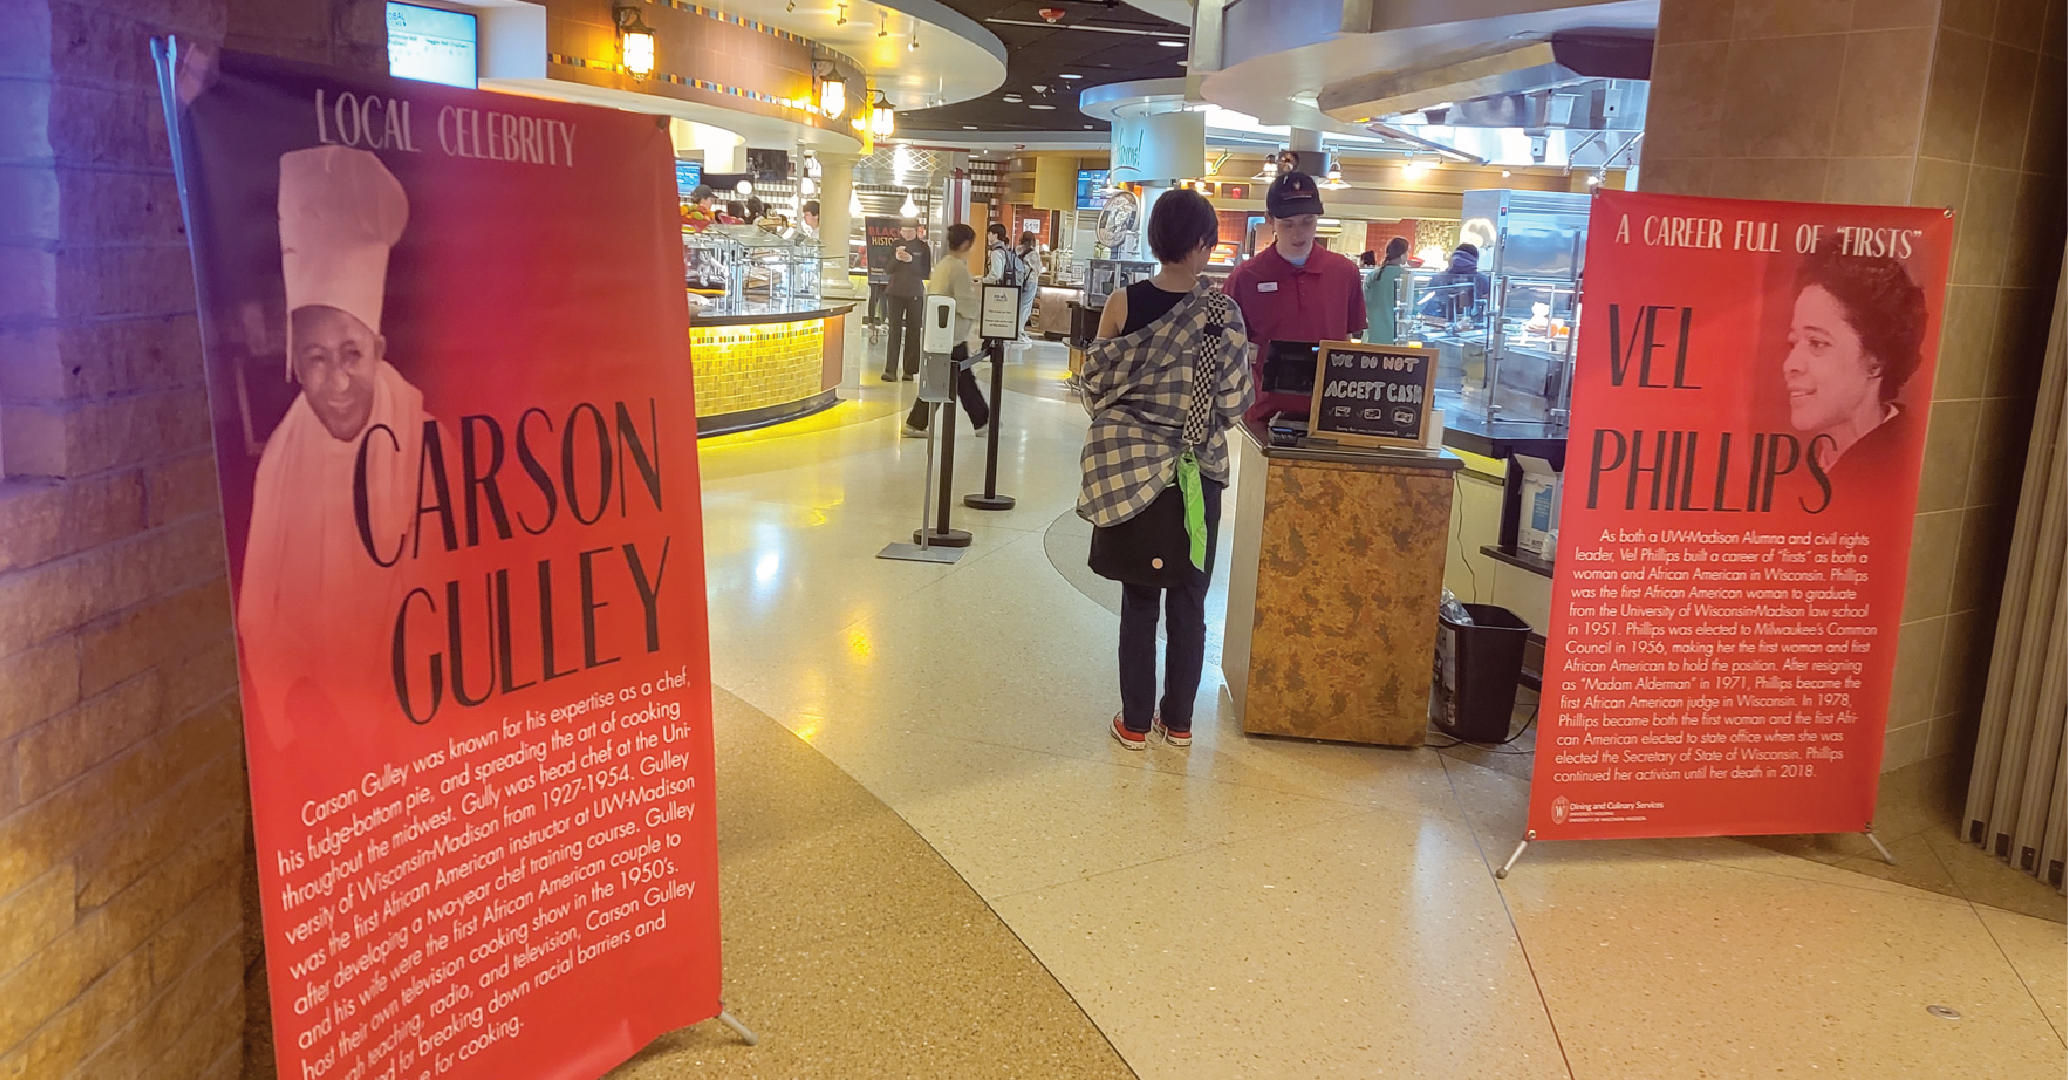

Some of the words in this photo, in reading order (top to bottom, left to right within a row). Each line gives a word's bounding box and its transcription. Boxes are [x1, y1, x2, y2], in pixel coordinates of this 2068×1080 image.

[315, 89, 422, 153] LOCAL
[437, 104, 578, 168] CELEBRITY
[1614, 213, 1631, 245] A
[1644, 215, 1722, 249] CAREER
[1734, 220, 1781, 252] FULL
[1796, 223, 1824, 254] OF
[1330, 353, 1354, 369] WE
[1360, 355, 1379, 369] DO
[1383, 356, 1420, 372] NOT
[1609, 302, 1702, 390] VEL
[1324, 380, 1386, 402] ACCEPT
[1386, 383, 1423, 404] CASH
[353, 398, 662, 568] CARSON
[1586, 428, 1838, 514] PHILLIPS
[1572, 569, 1618, 581] woman
[1620, 566, 1646, 581] and
[1646, 566, 1690, 581] African
[1691, 567, 1748, 581] American
[1749, 568, 1762, 581] in
[1829, 568, 1870, 586] Phillips
[1598, 528, 1617, 543] As
[1618, 528, 1646, 543] both
[1647, 533, 1659, 543] a
[1741, 530, 1786, 545] Alumna
[1787, 532, 1812, 546] and
[1813, 533, 1838, 546] civil
[1838, 533, 1871, 549] rights
[1619, 547, 1639, 562] Vel
[1640, 547, 1681, 566] Phillips
[1683, 548, 1709, 562] built
[1709, 552, 1720, 562] a
[1721, 552, 1761, 563] career
[1761, 549, 1776, 563] of
[1814, 553, 1829, 563] as
[1830, 550, 1857, 564] both
[1858, 554, 1870, 564] a
[391, 535, 671, 726] GULLEY
[1570, 588, 1597, 598] was
[1599, 584, 1619, 600] the
[1620, 584, 1642, 600] first
[1643, 585, 1686, 600] African
[1687, 585, 1743, 600] American
[1745, 589, 1790, 600] woman
[1790, 588, 1804, 600] to
[1804, 586, 1858, 604] graduate
[277, 849, 305, 877] his
[405, 785, 436, 817] pie,
[440, 762, 471, 795] and
[474, 740, 548, 785] spreading
[550, 729, 574, 752] the
[577, 721, 597, 742] art
[600, 710, 617, 734] of
[620, 701, 681, 730] cooking
[301, 788, 359, 827] Carson
[360, 763, 409, 798] Gulley
[412, 749, 446, 774] was
[448, 730, 499, 760] known
[502, 717, 523, 740] for
[525, 710, 547, 732] his
[550, 691, 615, 724] expertise
[619, 685, 637, 703] as
[640, 682, 653, 697] a
[655, 664, 691, 692] chef,
[1552, 767, 1612, 782] continued
[1613, 767, 1633, 781] her
[1634, 767, 1681, 781] activism
[1684, 766, 1708, 780] until
[1709, 765, 1729, 779] her
[1729, 765, 1763, 779] death
[1766, 766, 1777, 778] in
[282, 849, 364, 912] throughout
[366, 838, 390, 864] the
[392, 805, 457, 849] midwest.
[461, 783, 501, 815] Gully
[504, 774, 537, 798] was
[538, 751, 578, 785] head
[579, 740, 613, 769] chef
[615, 738, 631, 758] at
[635, 731, 659, 752] the
[284, 904, 335, 946] versity
[338, 882, 354, 915] of
[503, 803, 537, 828] from
[639, 750, 690, 776] Gulley
[1569, 803, 1592, 812] Dining
[1592, 802, 1606, 810] and
[1607, 801, 1634, 810] Culinary
[289, 948, 327, 980] was
[328, 929, 351, 957] the
[353, 909, 380, 940] first
[382, 881, 431, 923] African
[434, 846, 505, 891] American
[508, 817, 571, 855] instructor
[574, 806, 590, 827] at
[293, 979, 332, 1015] after
[333, 926, 409, 990] developing
[410, 916, 423, 935] a
[494, 856, 526, 891] chef
[529, 840, 583, 875] training
[586, 821, 641, 849] course.
[645, 800, 696, 828] Gulley
[298, 1006, 333, 1051] and
[333, 998, 356, 1025] his
[358, 970, 388, 1006] wife
[389, 950, 423, 983] were
[425, 934, 450, 958] the
[453, 915, 478, 943] first
[482, 890, 534, 929] African
[537, 859, 606, 901] American
[610, 834, 662, 868] couple
[665, 832, 682, 849] to
[301, 1045, 335, 1080] host
[338, 1022, 368, 1058] their
[370, 999, 400, 1031] own
[400, 956, 465, 1007] television
[468, 922, 530, 964] cooking
[531, 901, 571, 931] show
[573, 893, 587, 911] in
[591, 880, 615, 903] the
[429, 983, 474, 1018] radio,
[478, 954, 510, 988] and
[512, 927, 582, 971] television,
[585, 899, 640, 931] Carson
[643, 879, 696, 908] Gulley
[399, 1049, 415, 1074] for
[417, 1005, 484, 1058] breaking
[487, 981, 531, 1014] down
[533, 949, 574, 988] racial
[577, 929, 631, 965] barriers
[634, 908, 667, 938] and
[434, 1052, 455, 1077] for
[458, 1016, 525, 1061] cooking.
